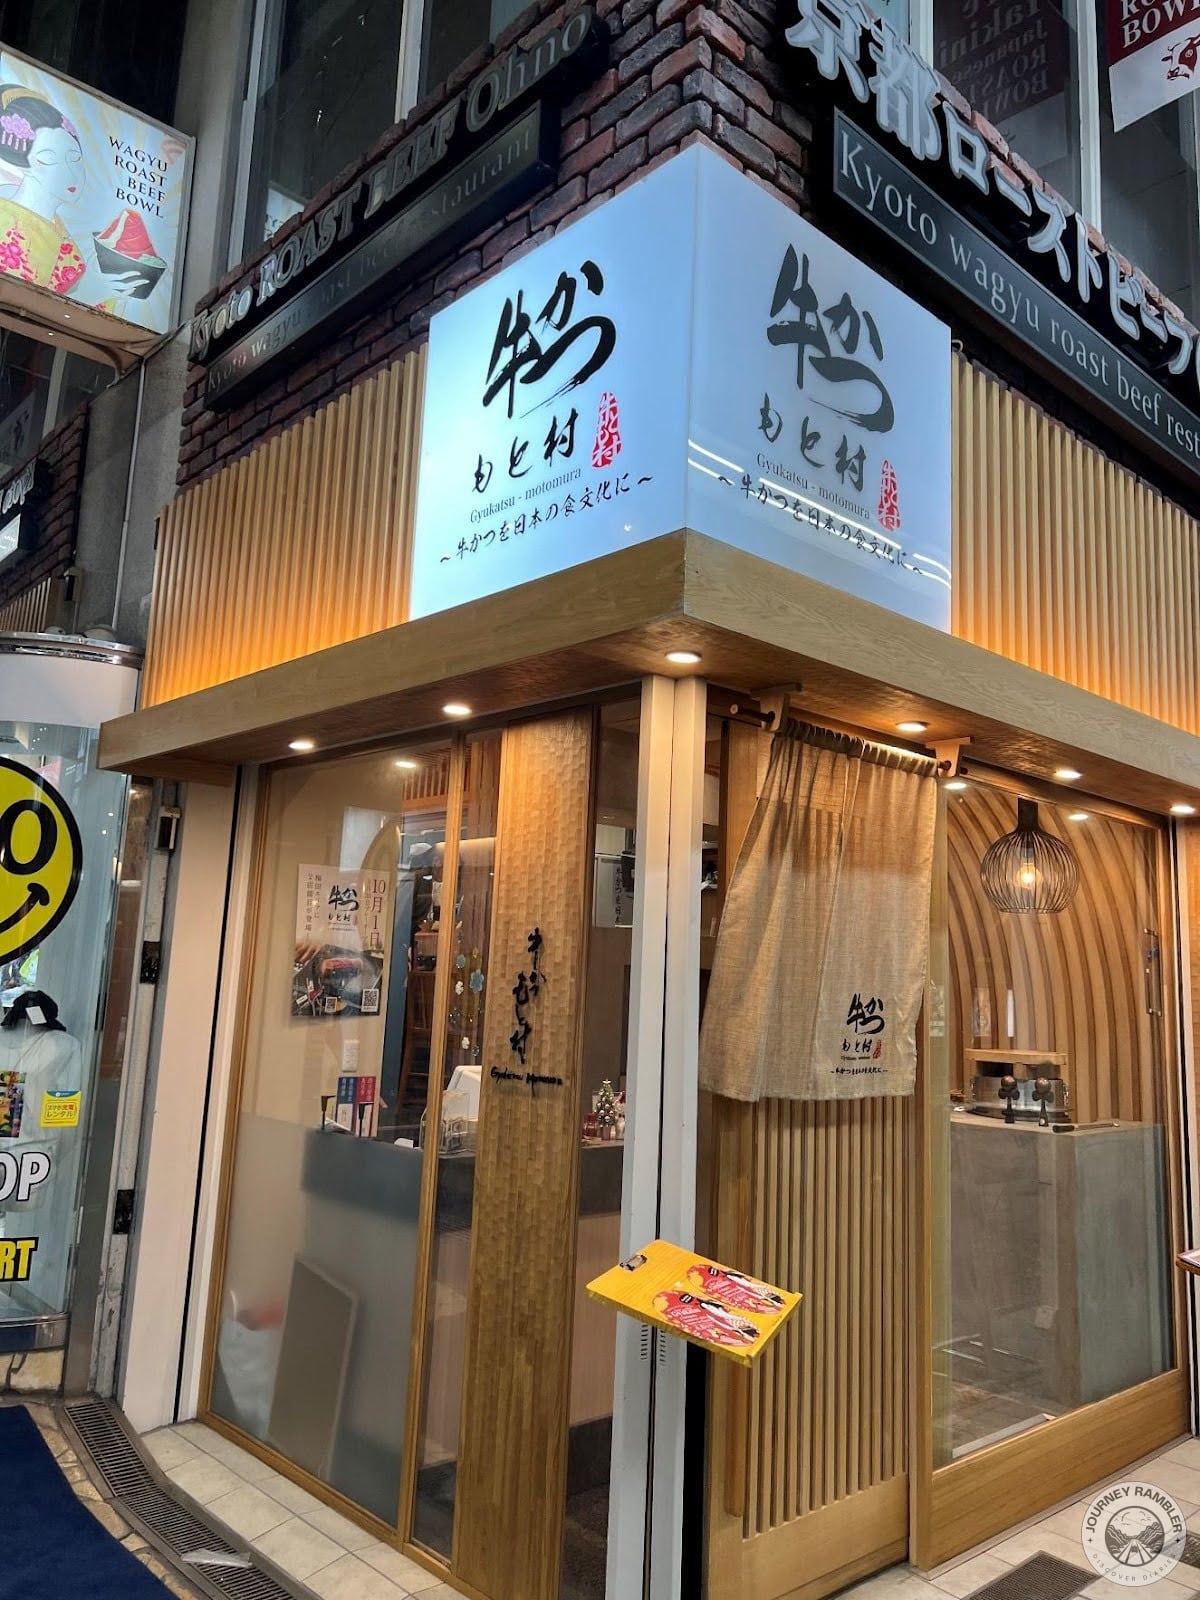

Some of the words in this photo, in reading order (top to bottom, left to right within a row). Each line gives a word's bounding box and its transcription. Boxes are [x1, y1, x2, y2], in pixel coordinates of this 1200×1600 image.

[109, 136, 167, 172] WAGYU
[115, 155, 167, 187] ROAST
[128, 177, 165, 202] BEEF
[188, 285, 253, 361] Kyoto
[256, 185, 363, 306] ROAST
[466, 5, 593, 132] Ohno
[116, 188, 164, 218] BOWL
[785, 0, 1200, 397] 京都ローストビーフ
[840, 130, 937, 245] Kyoto
[950, 234, 1040, 331] wagyu
[1050, 318, 1109, 386] roast
[1116, 361, 1161, 425] beef
[483, 260, 616, 419] 牛かつ
[767, 243, 894, 433] 牛かつ
[471, 407, 579, 494] もと村
[758, 391, 866, 493] もと村
[470, 494, 516, 524] Gyukatsu
[525, 467, 581, 501] motomura
[757, 453, 808, 491] Gyukatsu
[818, 486, 870, 520] motomura
